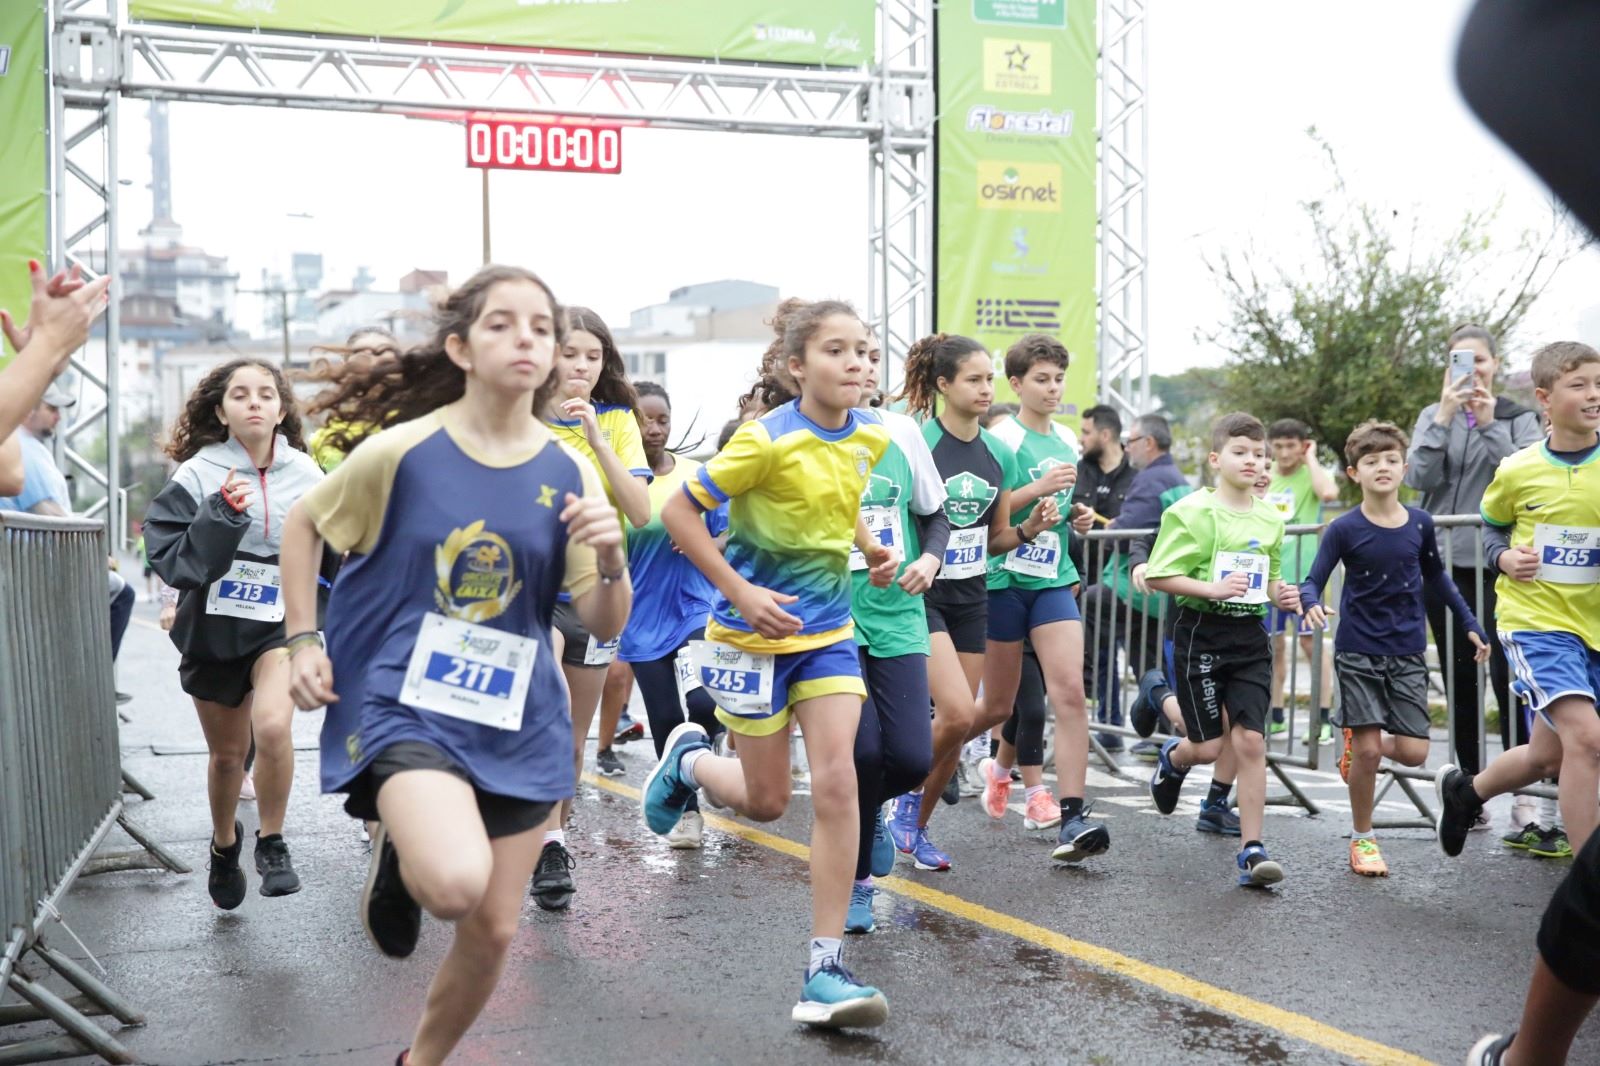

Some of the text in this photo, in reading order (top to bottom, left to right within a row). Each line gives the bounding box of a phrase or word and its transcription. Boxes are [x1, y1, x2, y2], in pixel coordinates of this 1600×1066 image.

[968, 106, 1072, 135] Florestal
[981, 181, 1057, 202] osirnet
[949, 500, 980, 514] RCR
[953, 548, 976, 564] 218
[1021, 547, 1049, 562] 204
[1551, 548, 1591, 566] 265
[228, 582, 263, 601] 213
[441, 657, 495, 692] 211
[709, 668, 746, 692] 245
